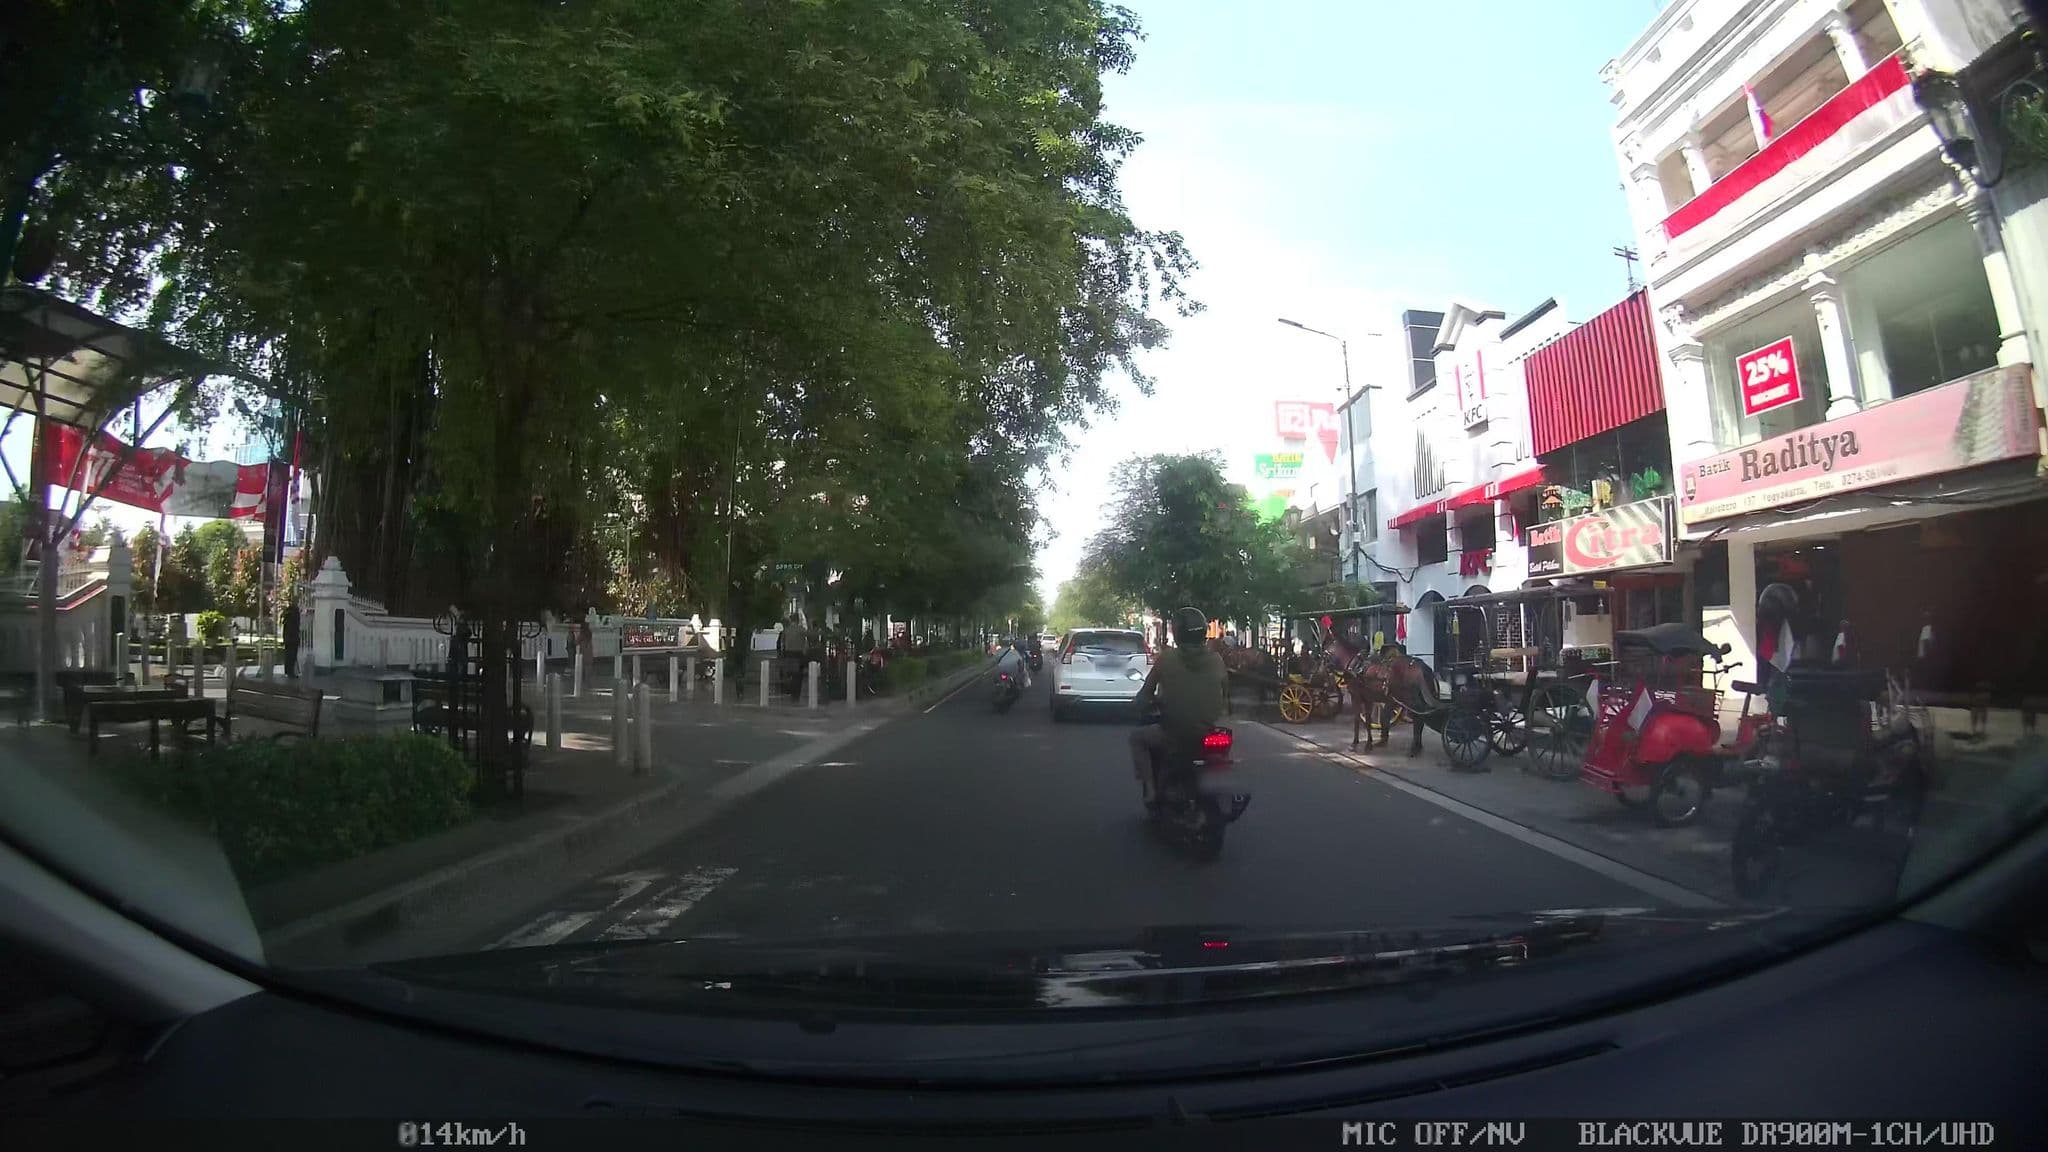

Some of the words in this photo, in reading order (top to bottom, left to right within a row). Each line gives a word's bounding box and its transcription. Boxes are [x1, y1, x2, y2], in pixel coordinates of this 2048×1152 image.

[1745, 350, 1790, 387] 25%
[1463, 403, 1483, 426] KFC
[1698, 458, 1731, 478] Batik
[1739, 430, 1859, 483] Raditya
[1565, 516, 1662, 569] Citra
